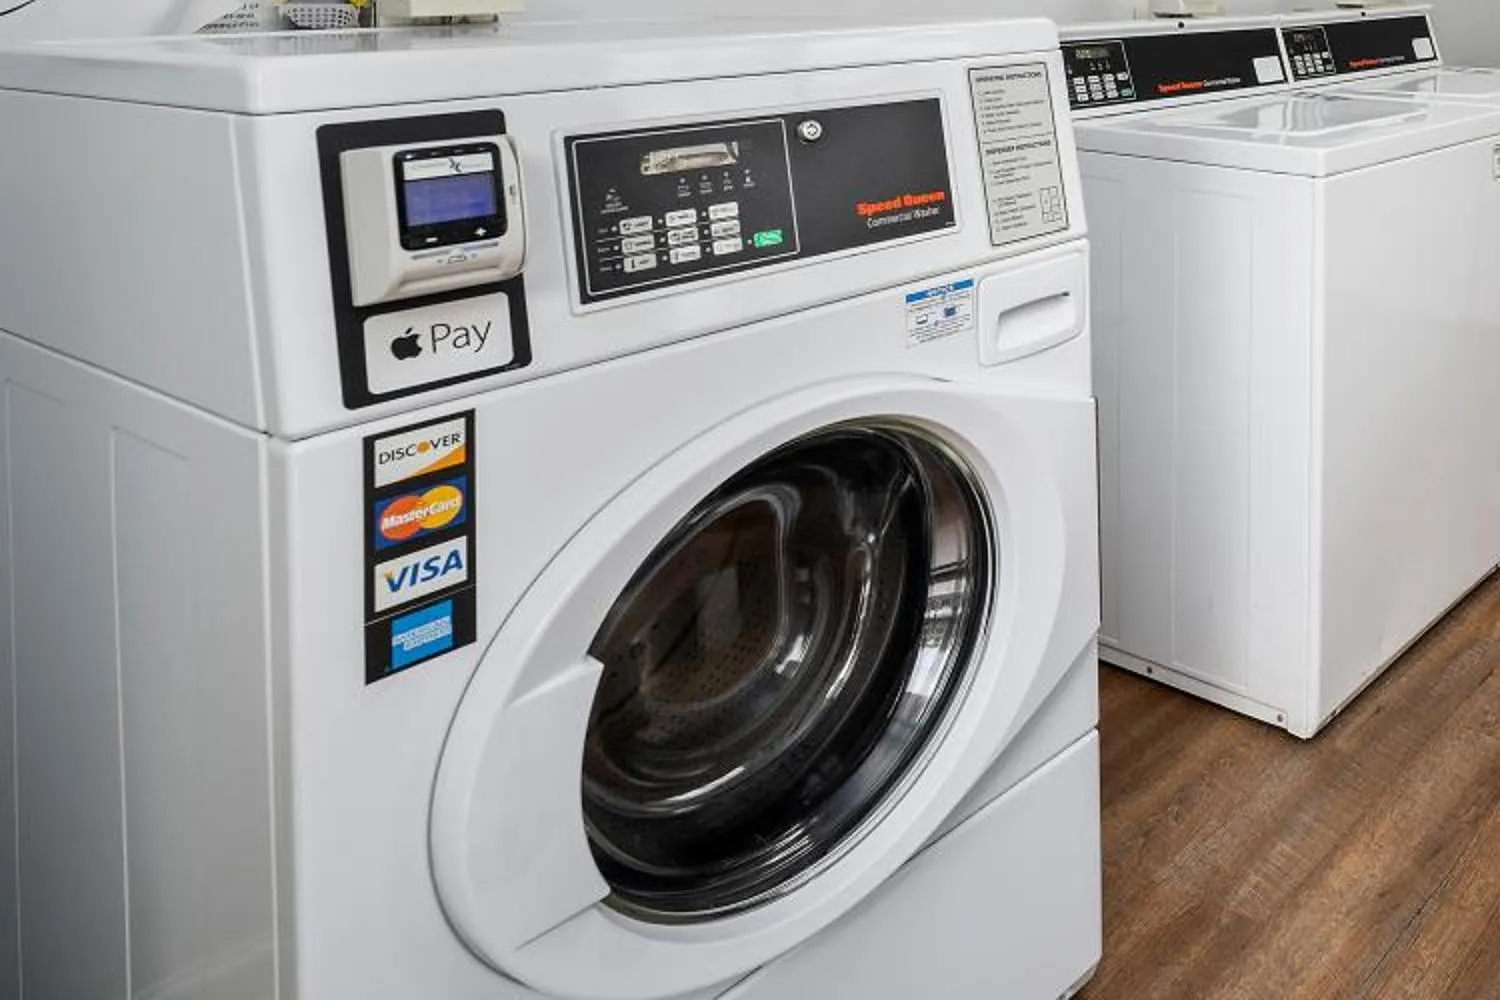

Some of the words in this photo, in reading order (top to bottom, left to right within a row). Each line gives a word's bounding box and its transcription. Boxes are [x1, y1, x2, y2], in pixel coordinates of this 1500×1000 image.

[855, 196, 903, 217] Speed
[903, 190, 945, 207] Queen
[430, 320, 492, 353] Pay
[378, 432, 462, 466] DISCOVER
[381, 497, 462, 531] MasterCard
[384, 548, 464, 594] VISA
